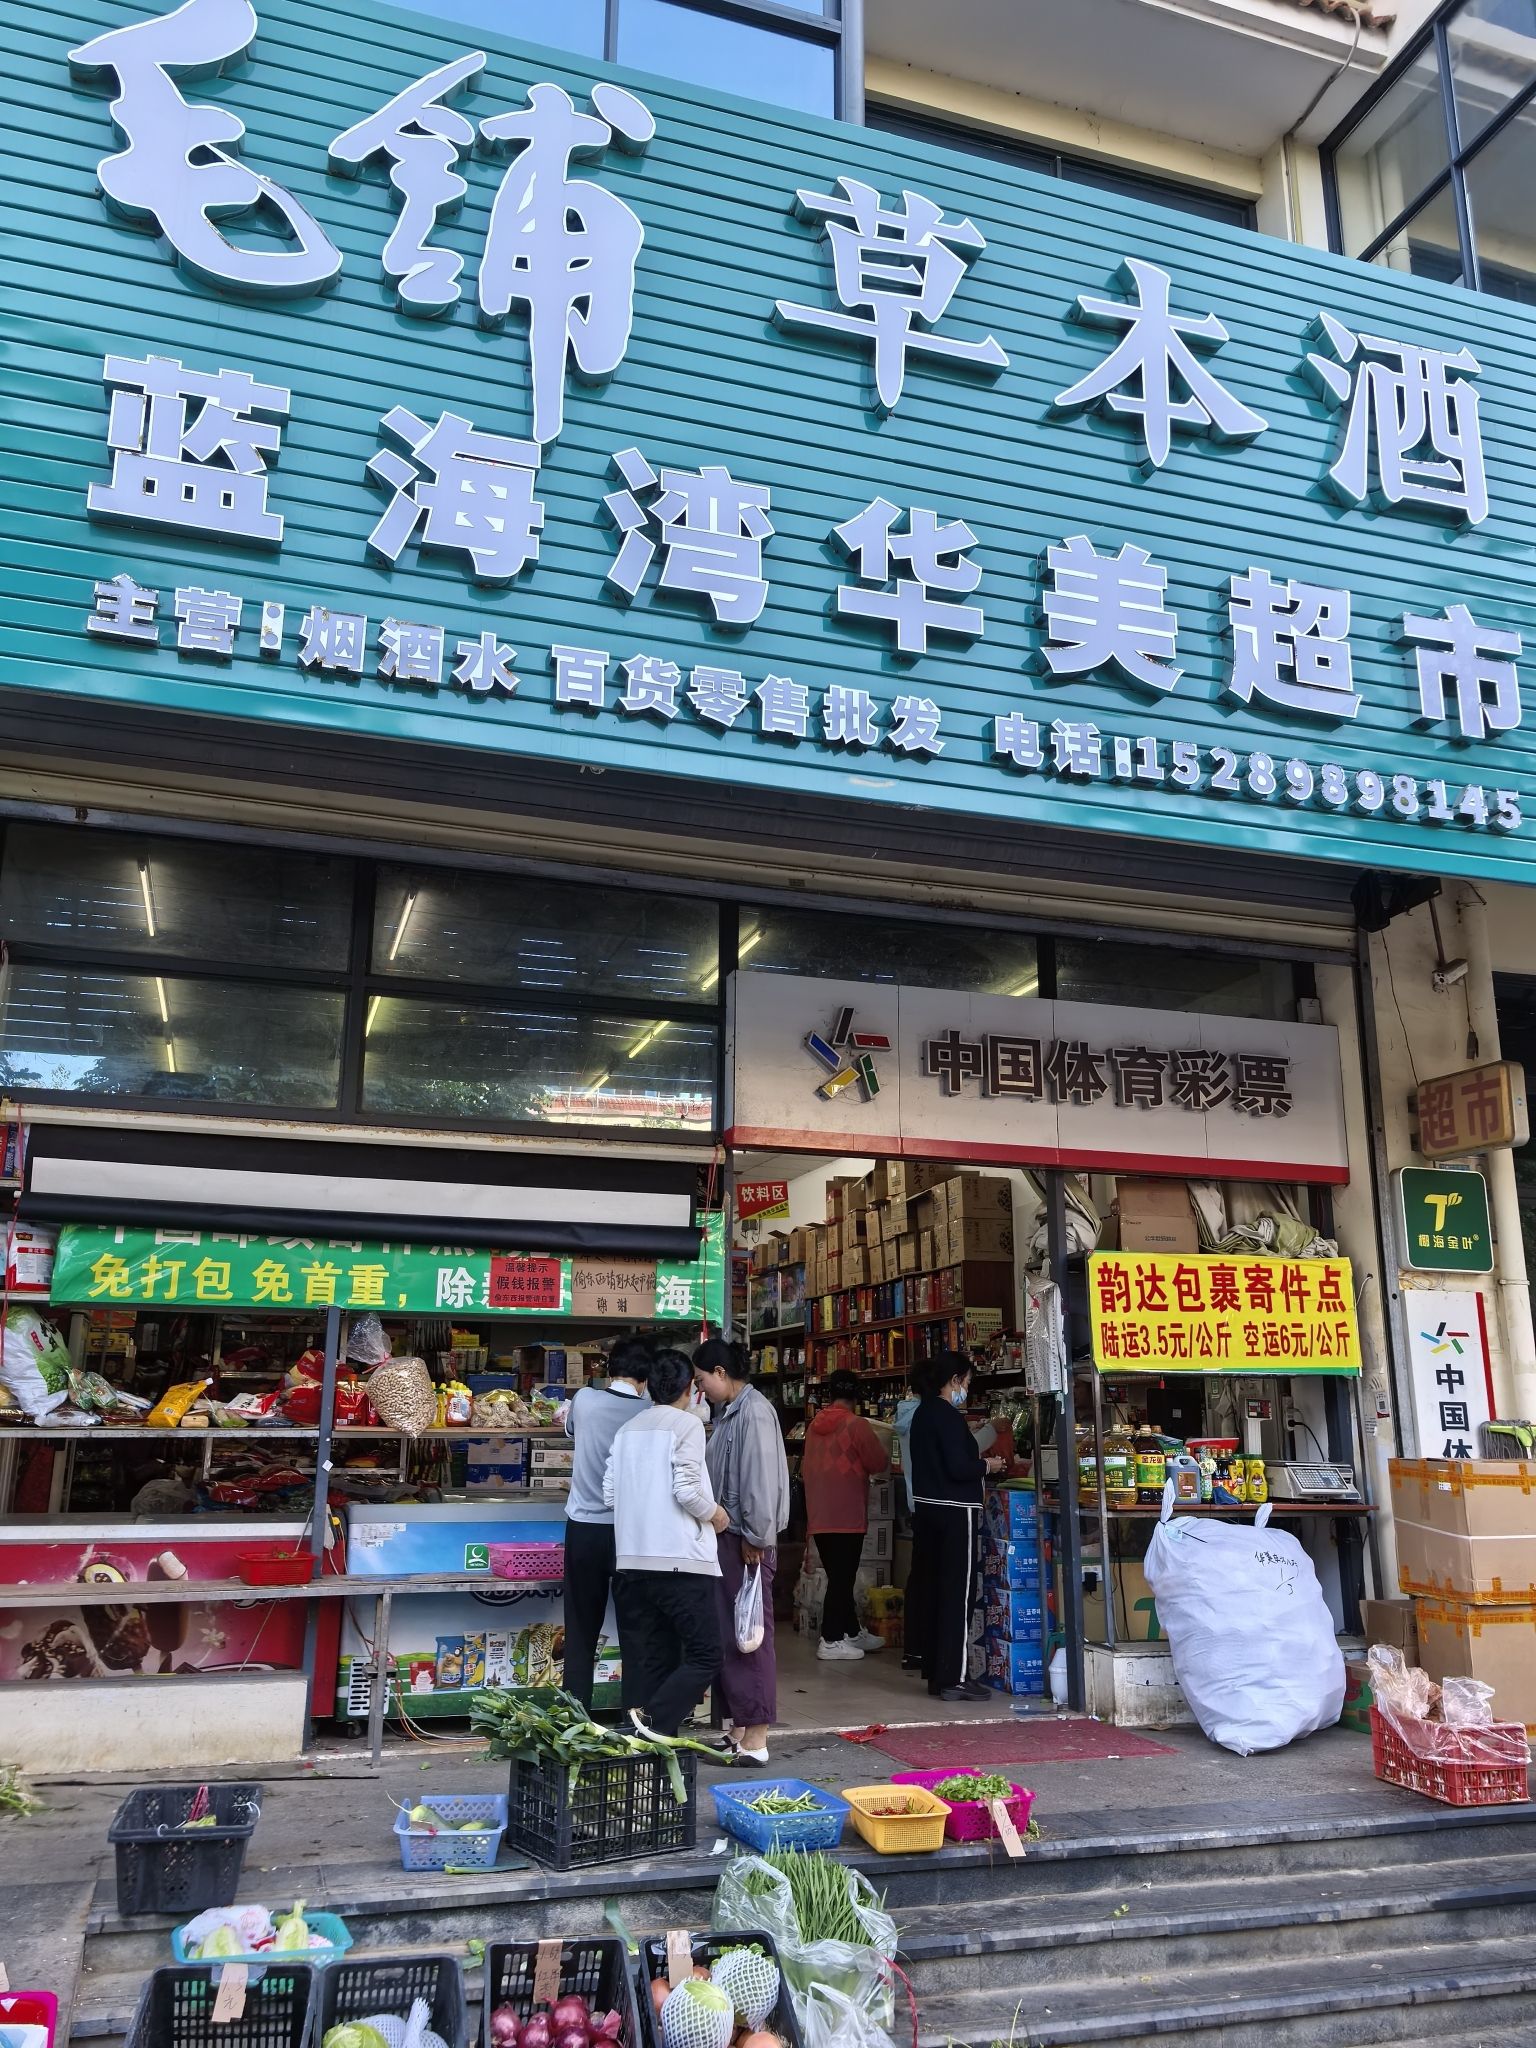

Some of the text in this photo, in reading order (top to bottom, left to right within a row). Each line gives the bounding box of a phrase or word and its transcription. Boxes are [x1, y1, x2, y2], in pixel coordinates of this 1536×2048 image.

[68, 0, 1490, 526] 毛铺 草本酒
[87, 353, 1523, 739] 蓝海湾华美超市
[551, 644, 946, 755] 百货零售批发
[926, 1029, 1295, 1116] 中国体育彩票
[1419, 1071, 1501, 1149] 超市
[741, 1185, 785, 1203] 饮料区
[88, 1252, 233, 1301] 免打包
[496, 1275, 556, 1292] 假钱报警
[505, 1262, 549, 1273] 温馨提示
[1097, 1261, 1347, 1314] 韵达包裹寄件点
[1100, 1320, 1350, 1359] 陆运3.5元/公斤 空运6元/公斤
